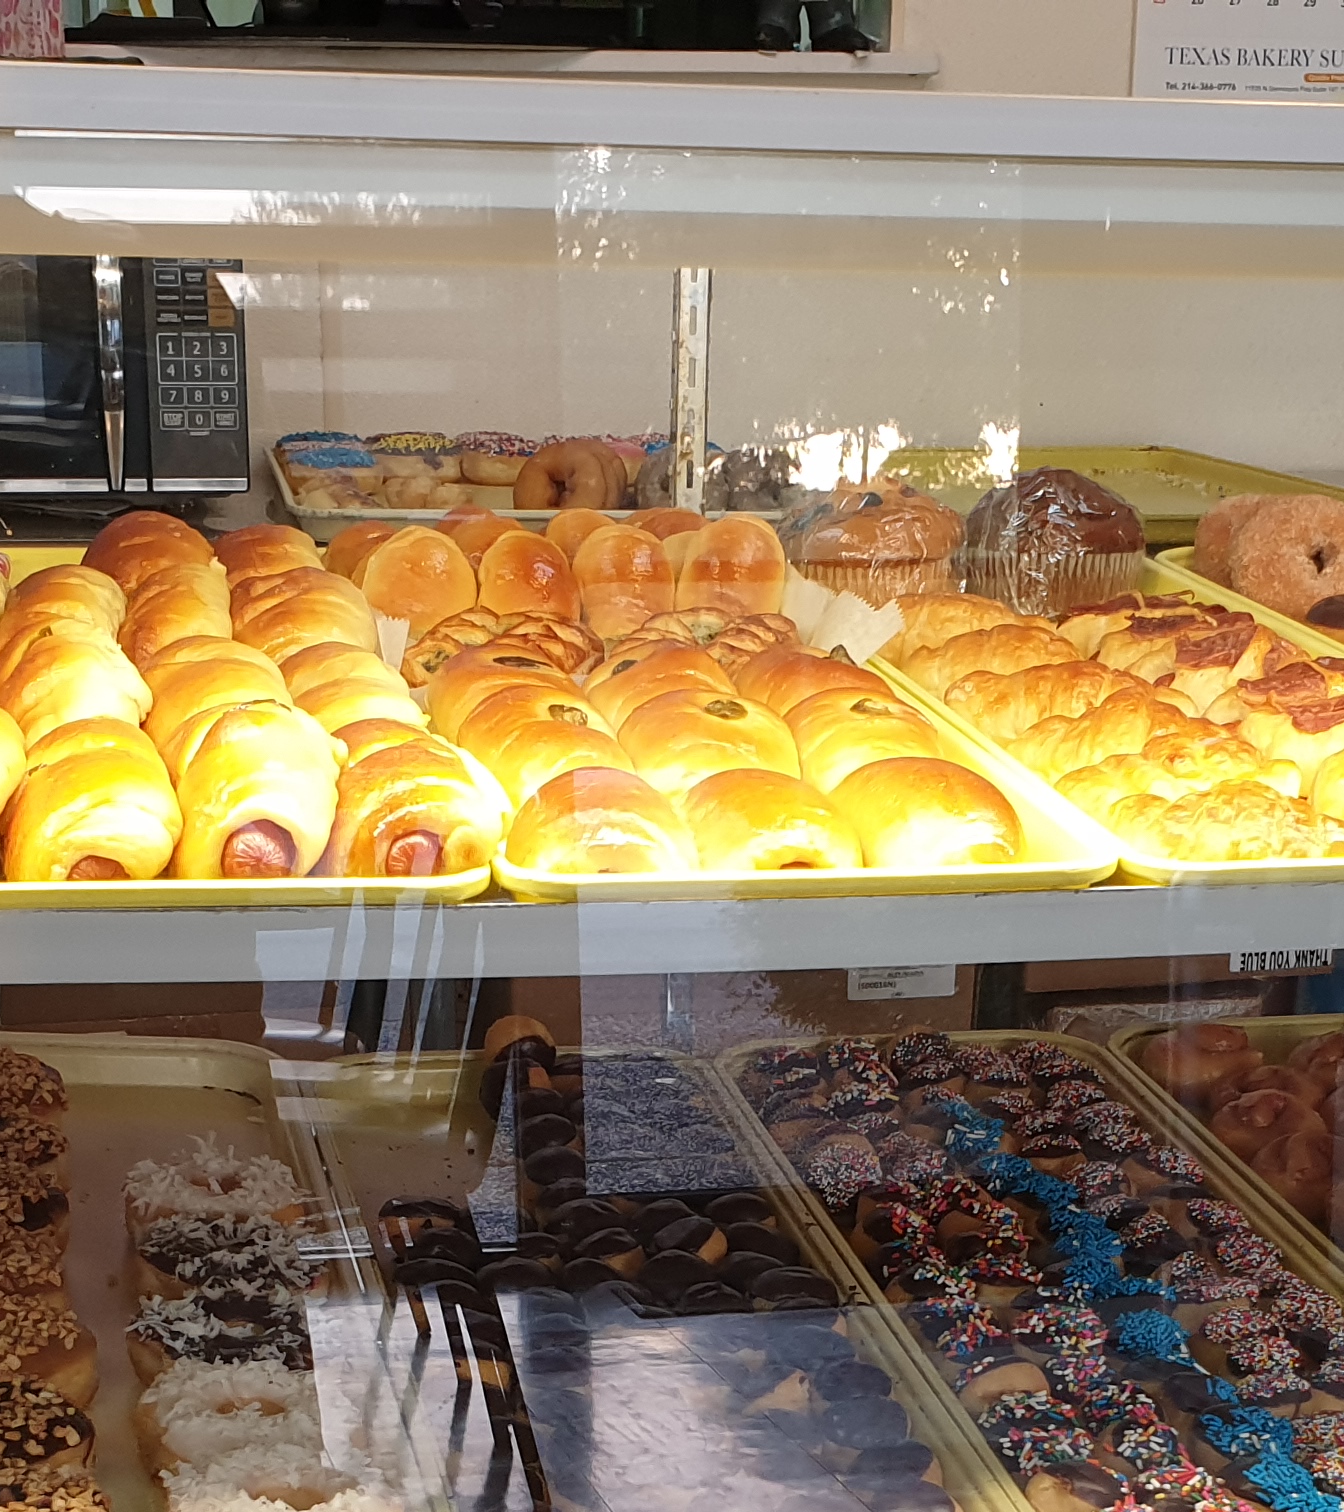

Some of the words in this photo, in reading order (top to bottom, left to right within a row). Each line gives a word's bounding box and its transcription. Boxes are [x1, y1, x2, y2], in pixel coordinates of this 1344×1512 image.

[1164, 47, 1231, 66] TEXAS
[1237, 48, 1315, 68] BAKERY
[1165, 81, 1179, 90] Tel.
[167, 341, 175, 354] 1
[193, 342, 201, 355] 2
[219, 342, 227, 355] 3
[166, 364, 175, 377] 4
[194, 364, 201, 378] 5
[220, 364, 228, 377] 6
[169, 390, 177, 402] 7
[194, 390, 203, 403] 8
[221, 390, 229, 403] 9
[195, 413, 203, 425] 0
[1240, 951, 1266, 971] BLUE
[1269, 950, 1290, 970] YOU
[1293, 949, 1328, 968] THANK
